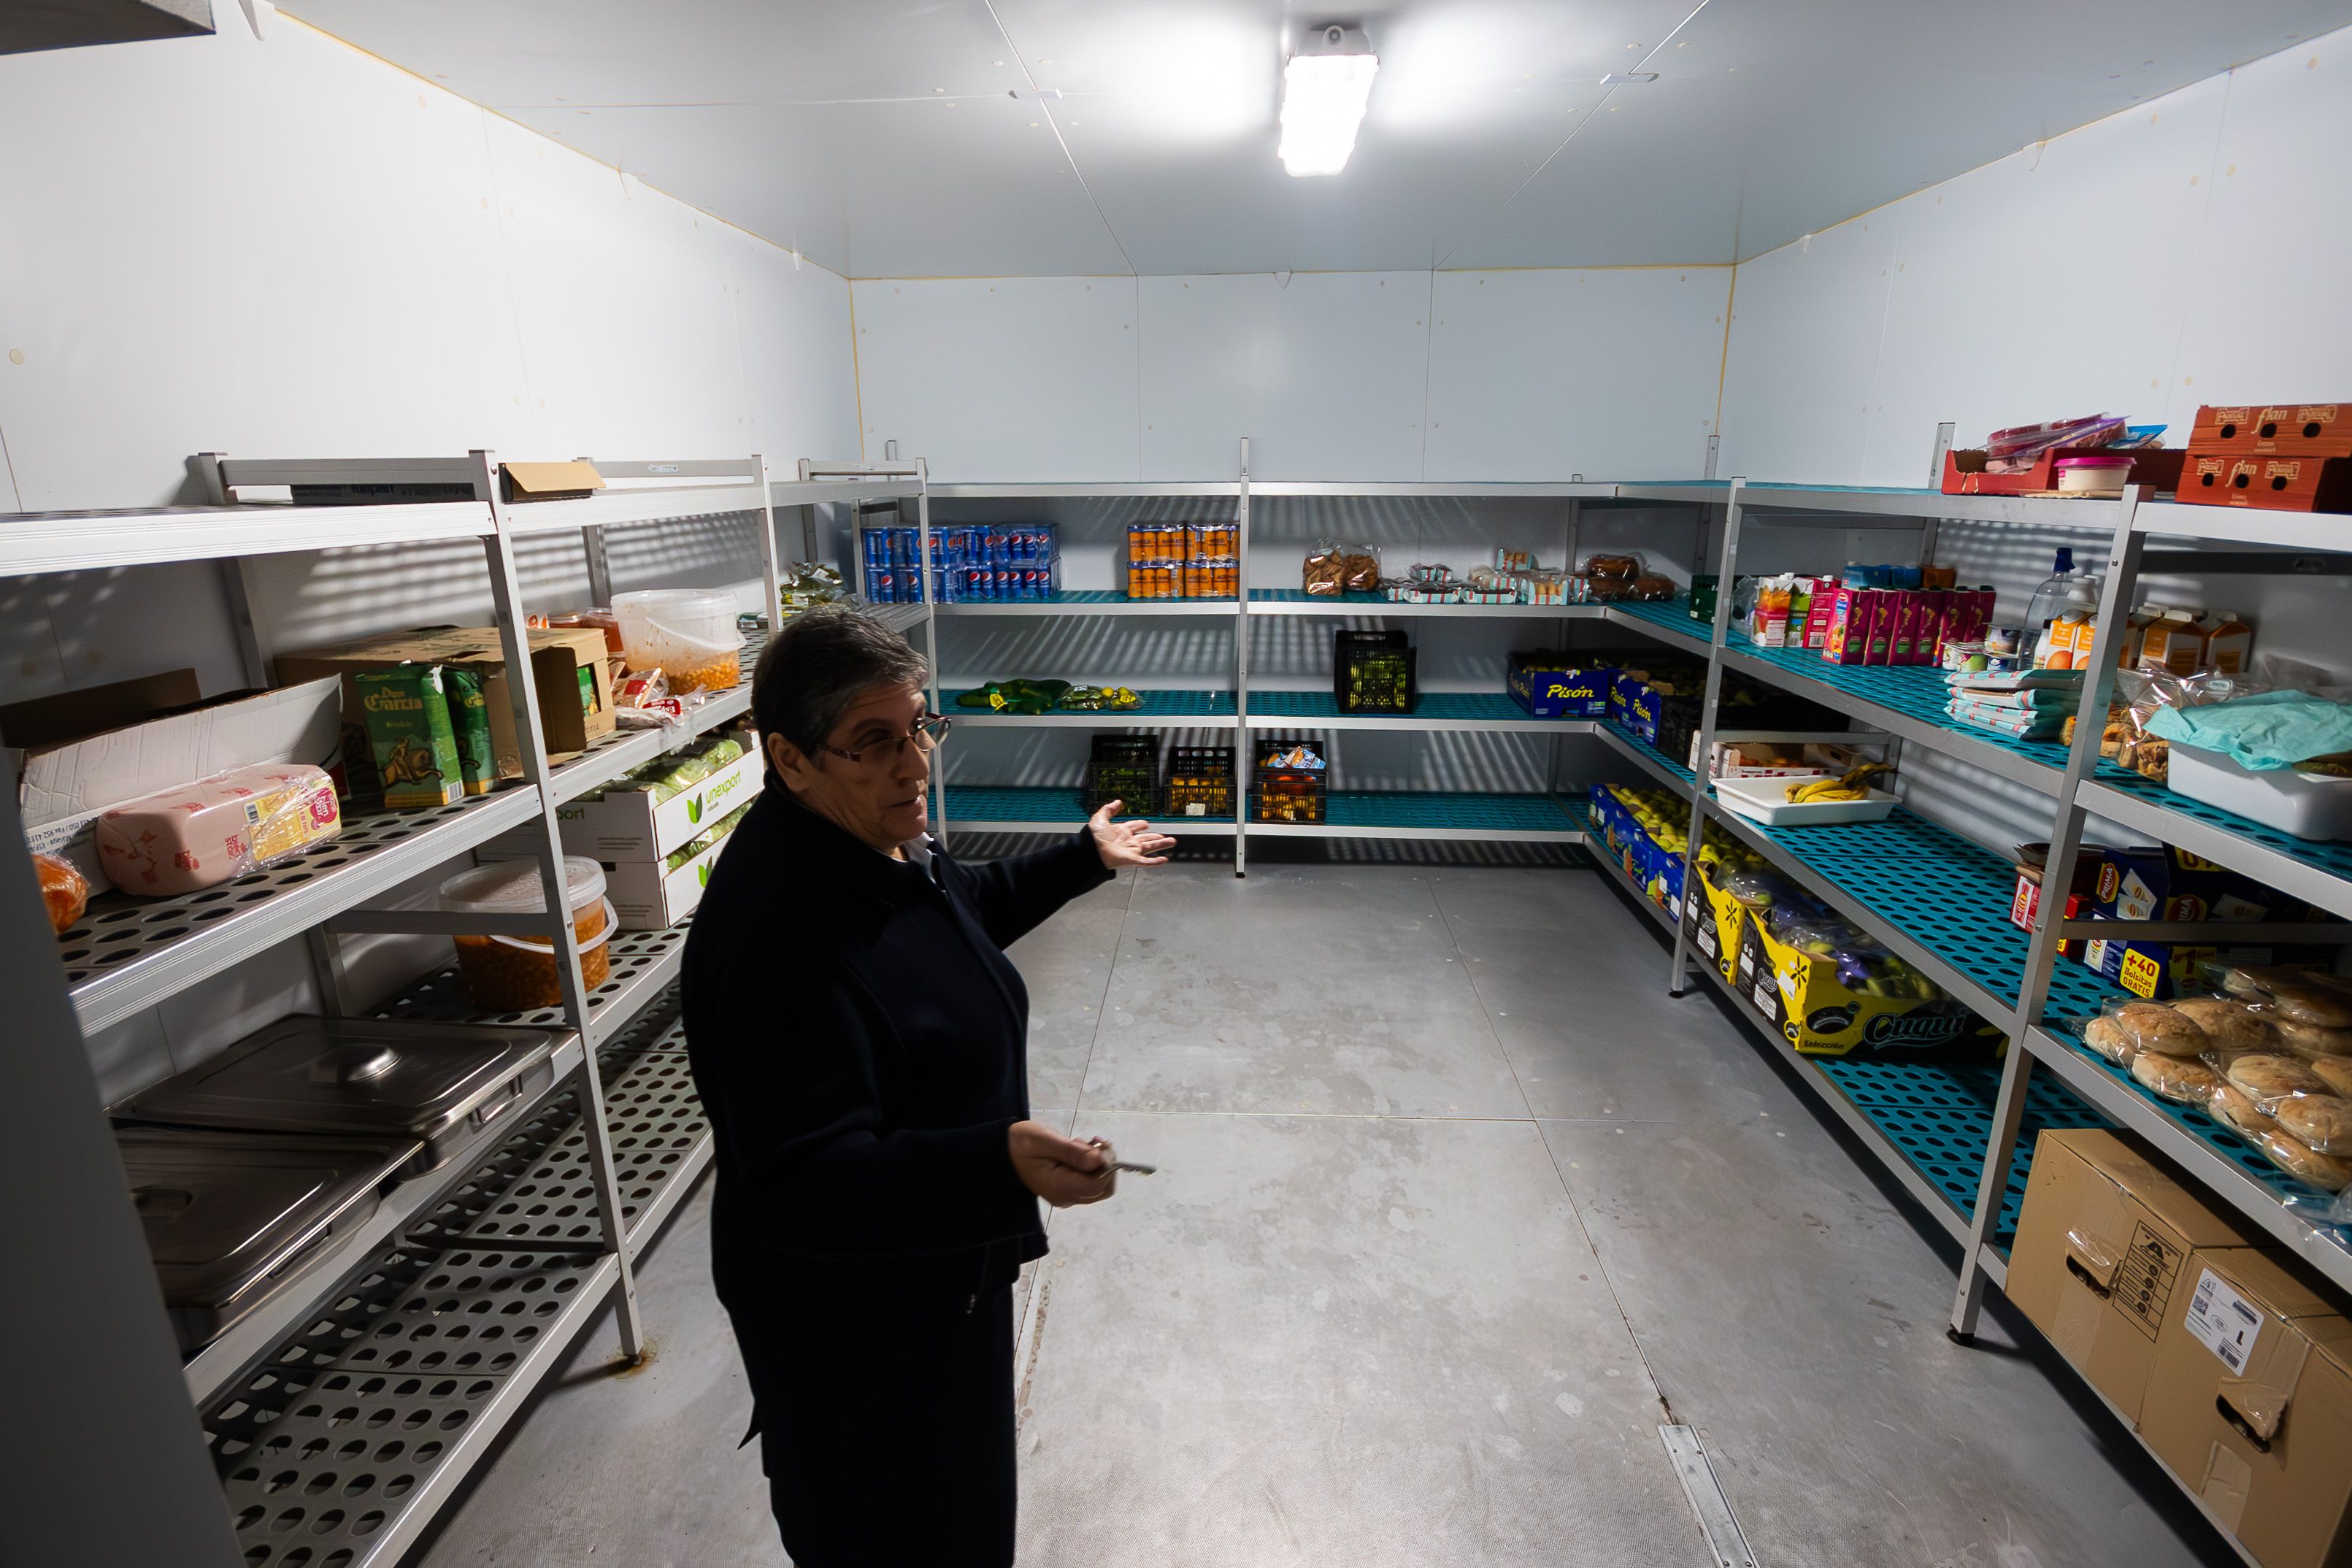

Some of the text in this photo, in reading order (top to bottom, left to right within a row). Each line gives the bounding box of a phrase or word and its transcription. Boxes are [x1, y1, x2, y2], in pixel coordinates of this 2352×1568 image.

[2251, 405, 2288, 434] flan
[2225, 459, 2258, 487] flan
[1547, 684, 1595, 699] Pisón
[1633, 699, 1651, 722] Pisón
[706, 769, 741, 804] unexport
[2124, 966, 2153, 988] Bolsitas
[2127, 955, 2156, 977] +40
[2123, 977, 2151, 997] GRATIS
[1863, 1008, 1969, 1049] Cuqui
